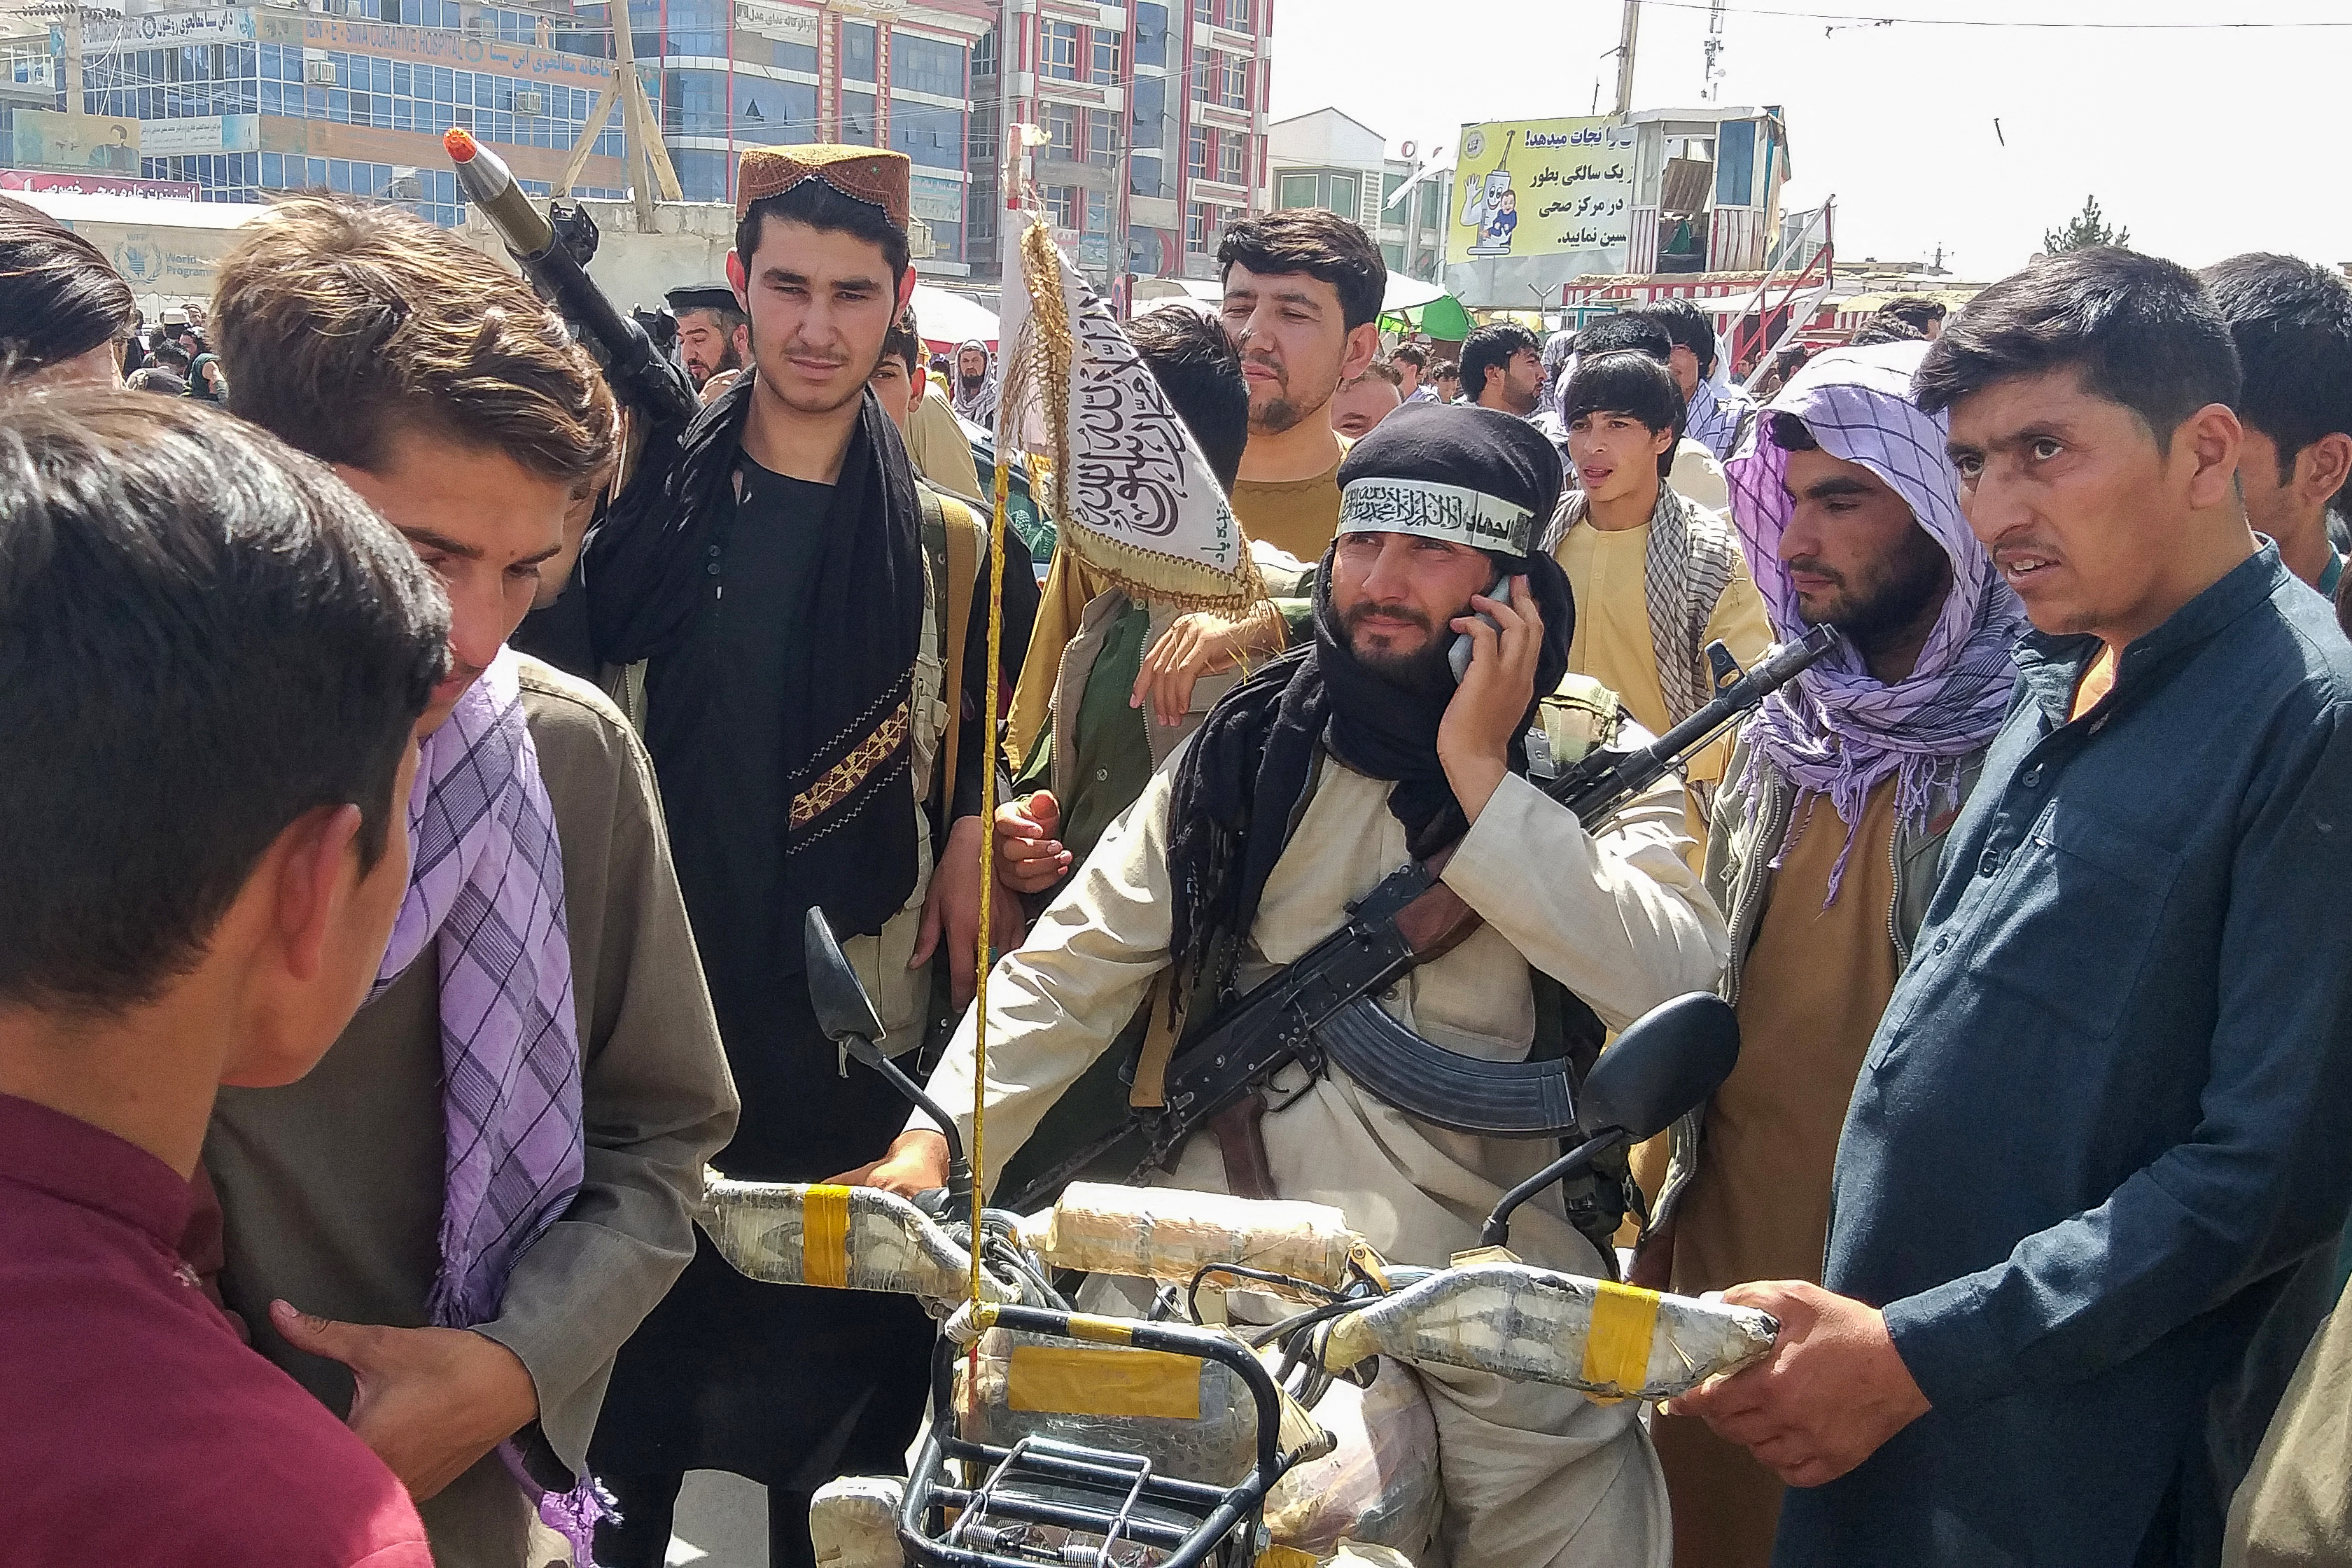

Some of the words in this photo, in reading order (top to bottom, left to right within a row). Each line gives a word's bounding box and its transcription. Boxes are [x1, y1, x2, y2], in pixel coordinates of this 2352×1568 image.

[420, 31, 463, 59] HOSPITAL
[1570, 126, 1602, 148] نجات
[1529, 166, 1559, 188] بطور
[1562, 164, 1601, 186] سالگی
[1604, 163, 1624, 183] یک
[1539, 200, 1572, 218] صحی
[1574, 195, 1604, 217] مرکز
[1606, 198, 1623, 216] در
[165, 252, 197, 264] World
